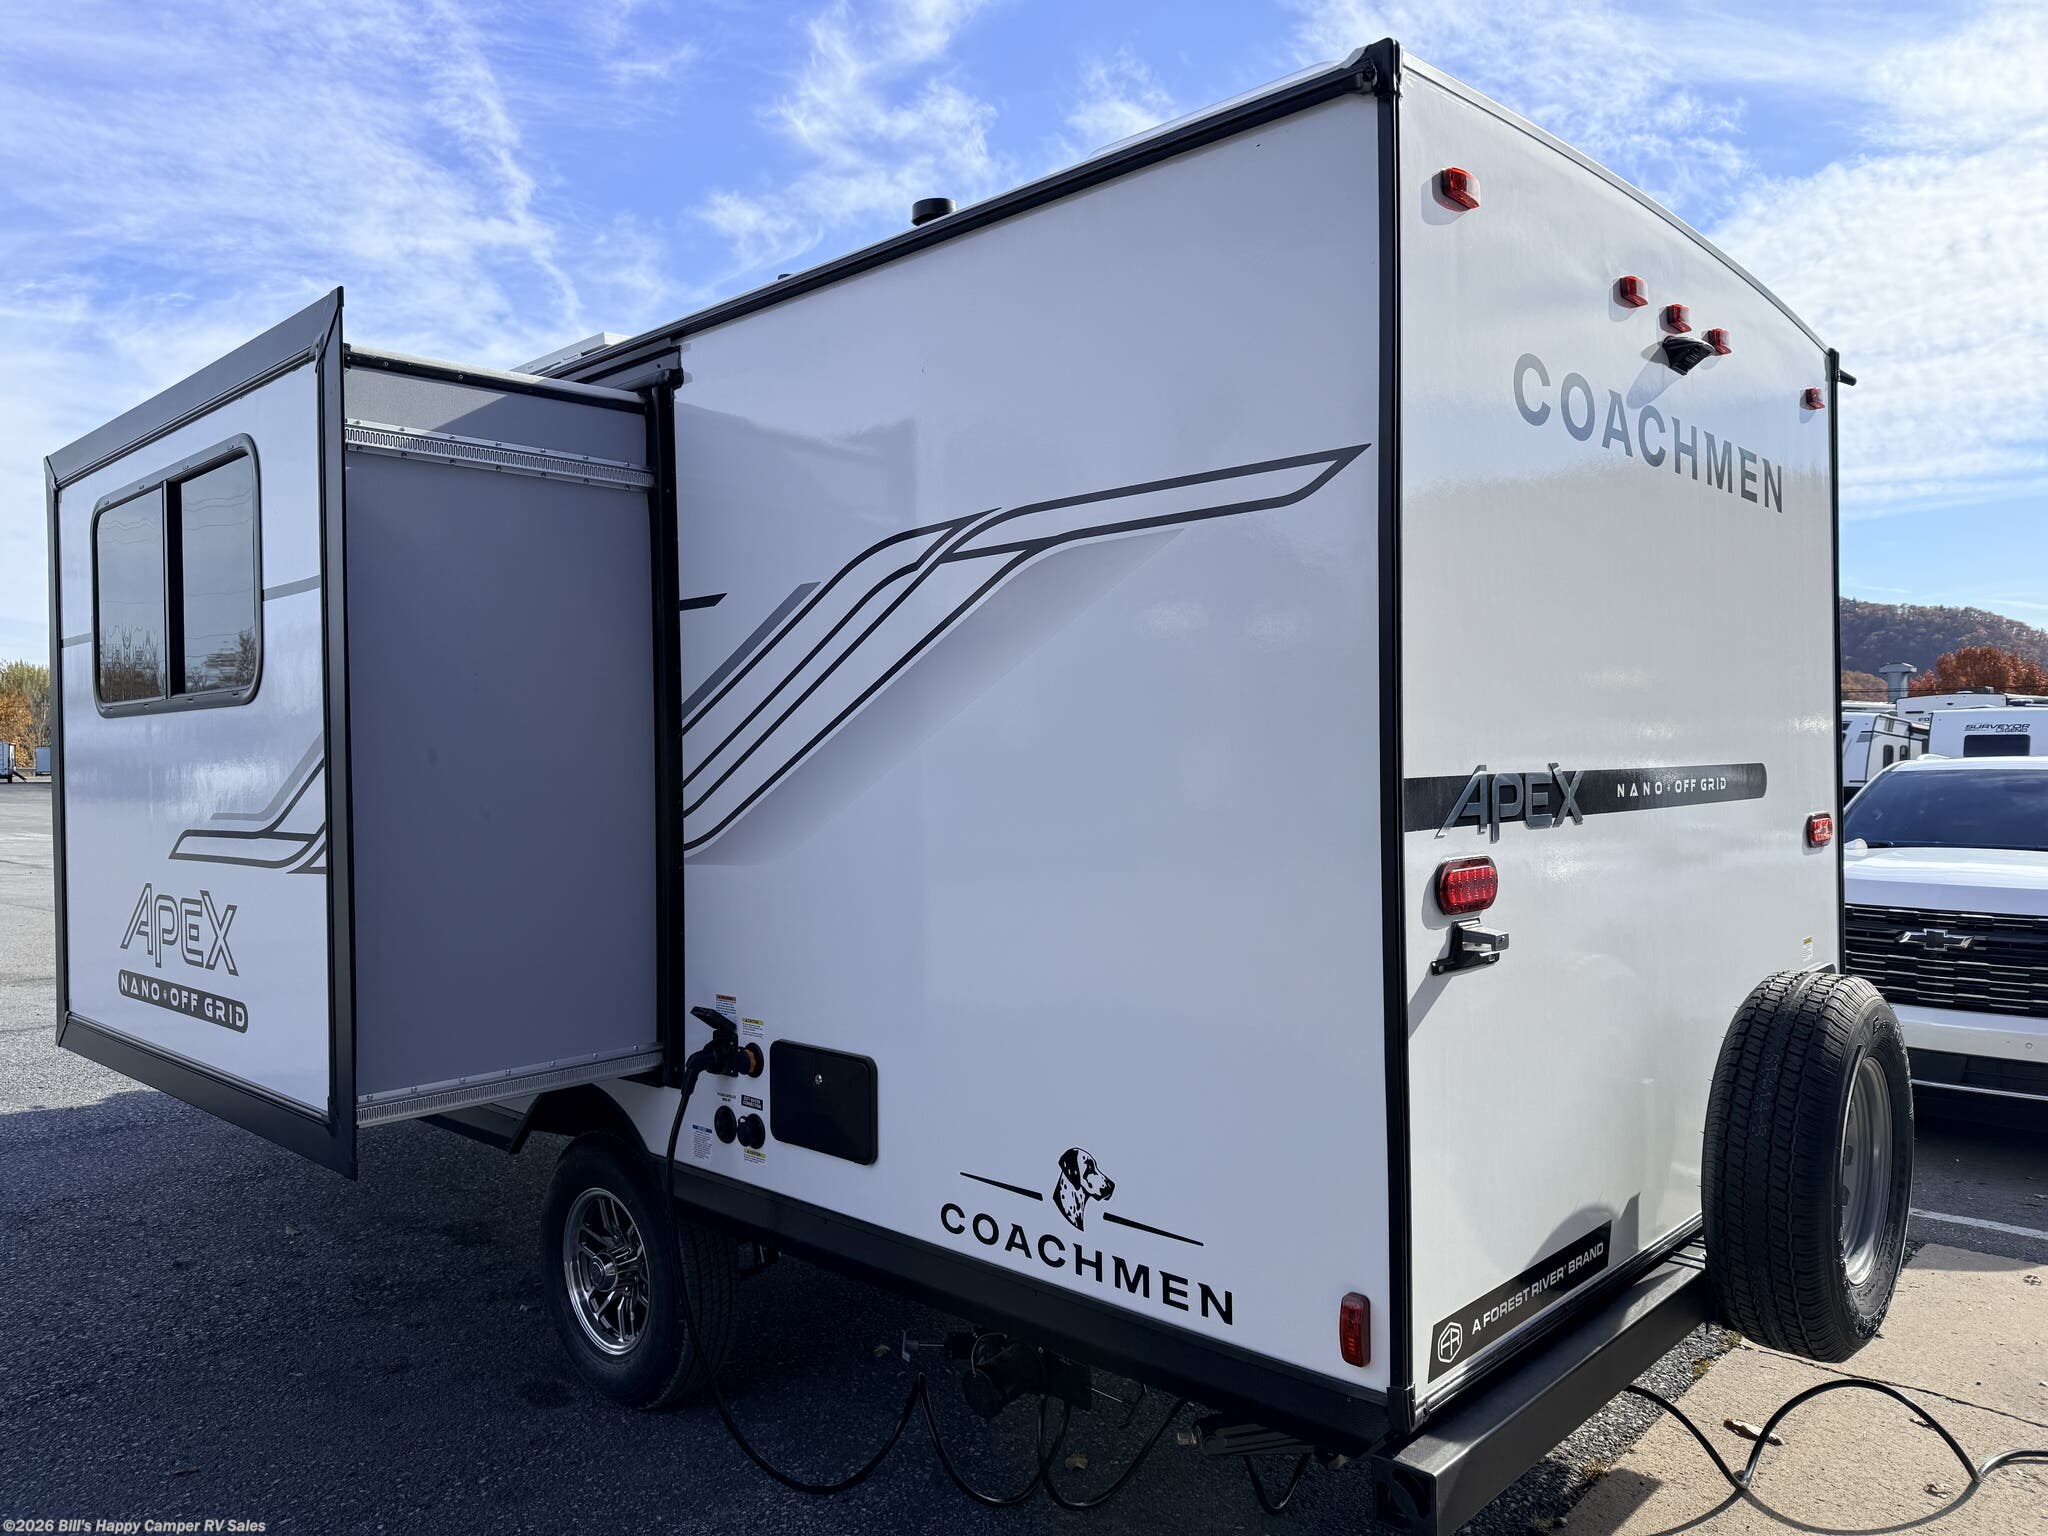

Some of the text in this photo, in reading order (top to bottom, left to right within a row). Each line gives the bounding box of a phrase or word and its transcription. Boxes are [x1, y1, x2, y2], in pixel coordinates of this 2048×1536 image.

[1513, 352, 1783, 514] COACHMEN
[1434, 762, 1585, 844] APEX
[1616, 777, 1727, 798] NANO OFF GRID
[120, 882, 239, 977] APEX
[121, 973, 245, 1028] NANO OFF GRID
[940, 1203, 1233, 1326] COACHMEN
[1471, 1318, 1482, 1336] A
[1483, 1287, 1532, 1328] FOREST
[1568, 1241, 1604, 1275] BRAND
